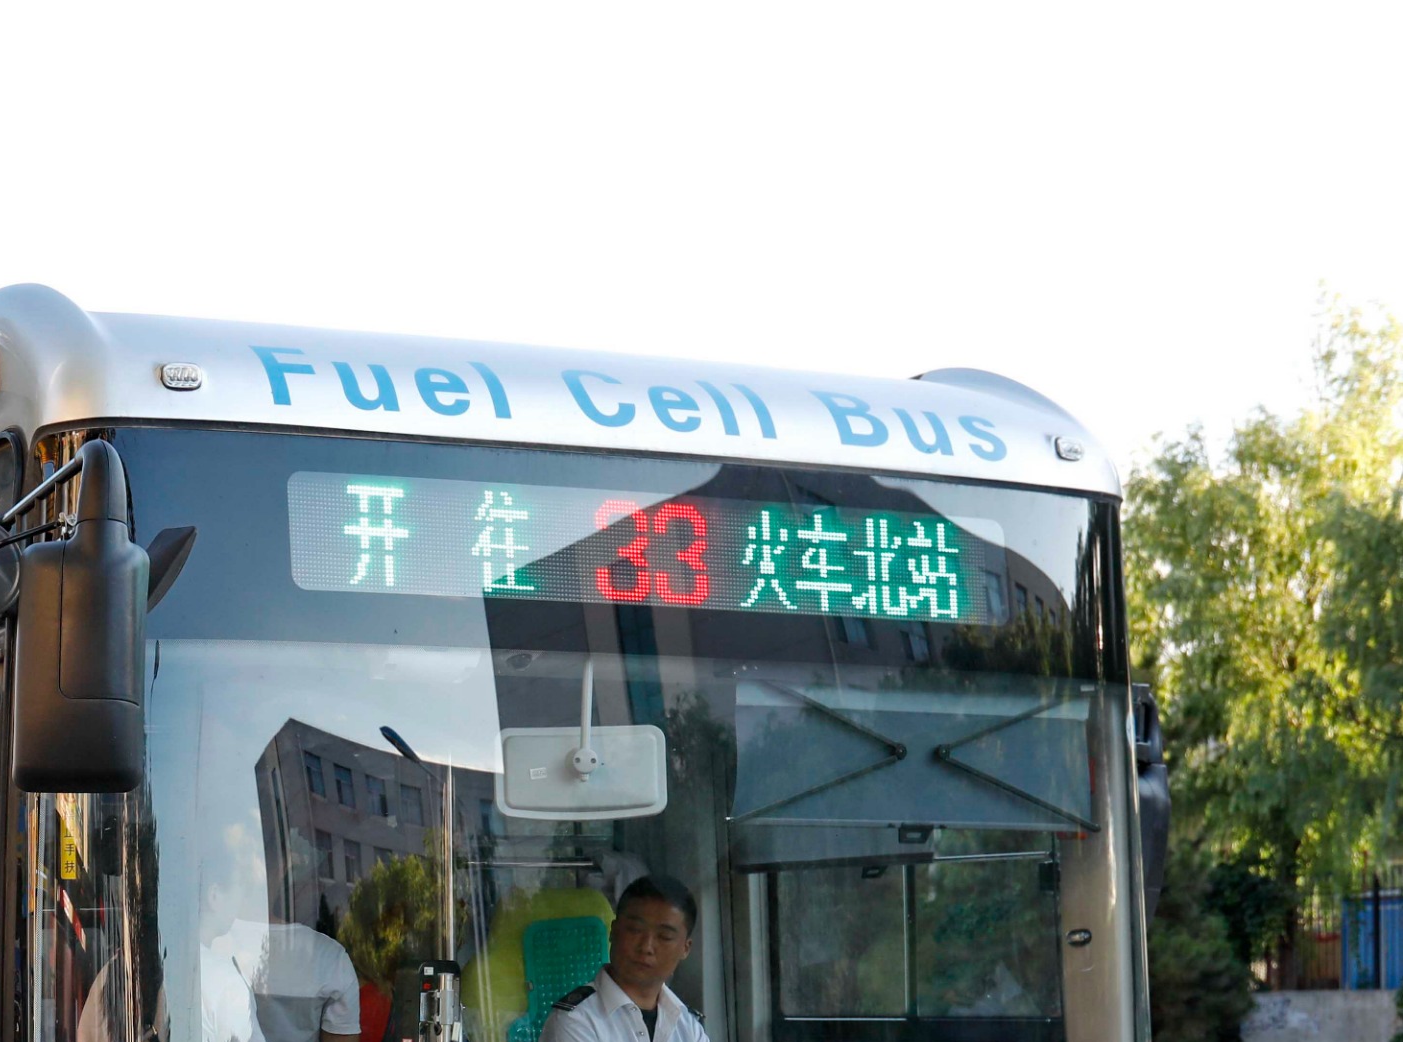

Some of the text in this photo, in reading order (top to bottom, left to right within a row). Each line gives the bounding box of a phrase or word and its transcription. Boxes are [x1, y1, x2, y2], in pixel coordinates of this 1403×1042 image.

[251, 345, 1008, 462] Fuel Cell Bus
[596, 499, 710, 606] 33
[740, 509, 960, 619] 火车北站
